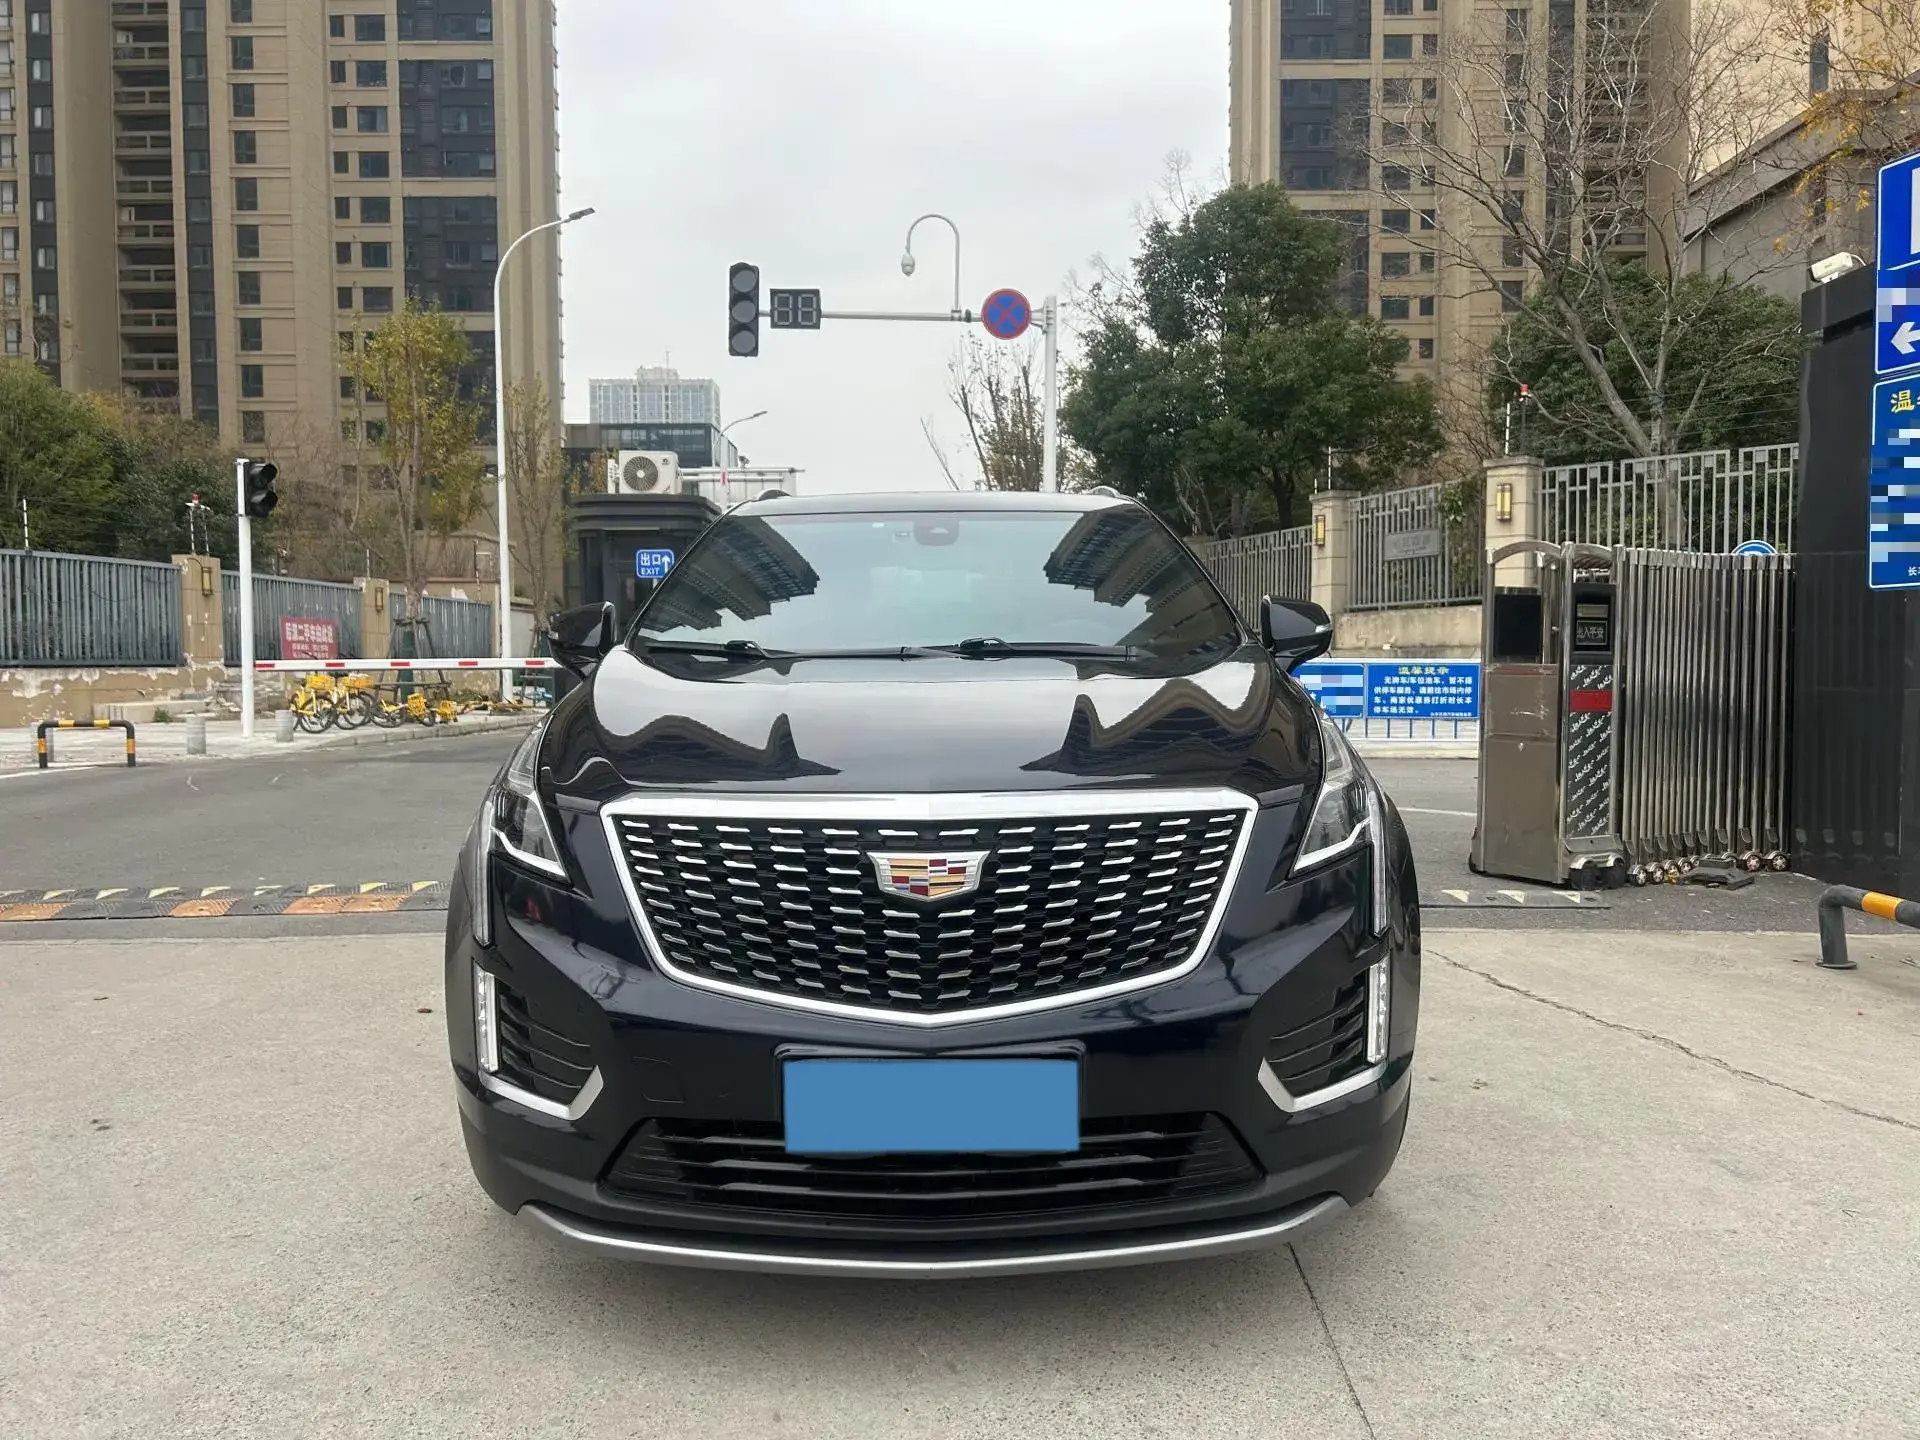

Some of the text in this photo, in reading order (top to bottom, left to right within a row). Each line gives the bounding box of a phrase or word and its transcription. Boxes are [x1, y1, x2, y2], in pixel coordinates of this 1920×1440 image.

[1890, 389, 1920, 414] 温
[640, 552, 661, 566] 出口
[641, 567, 660, 575] EXIT
[1908, 566, 1920, 577] 长
[1398, 666, 1450, 675] 温馨提示
